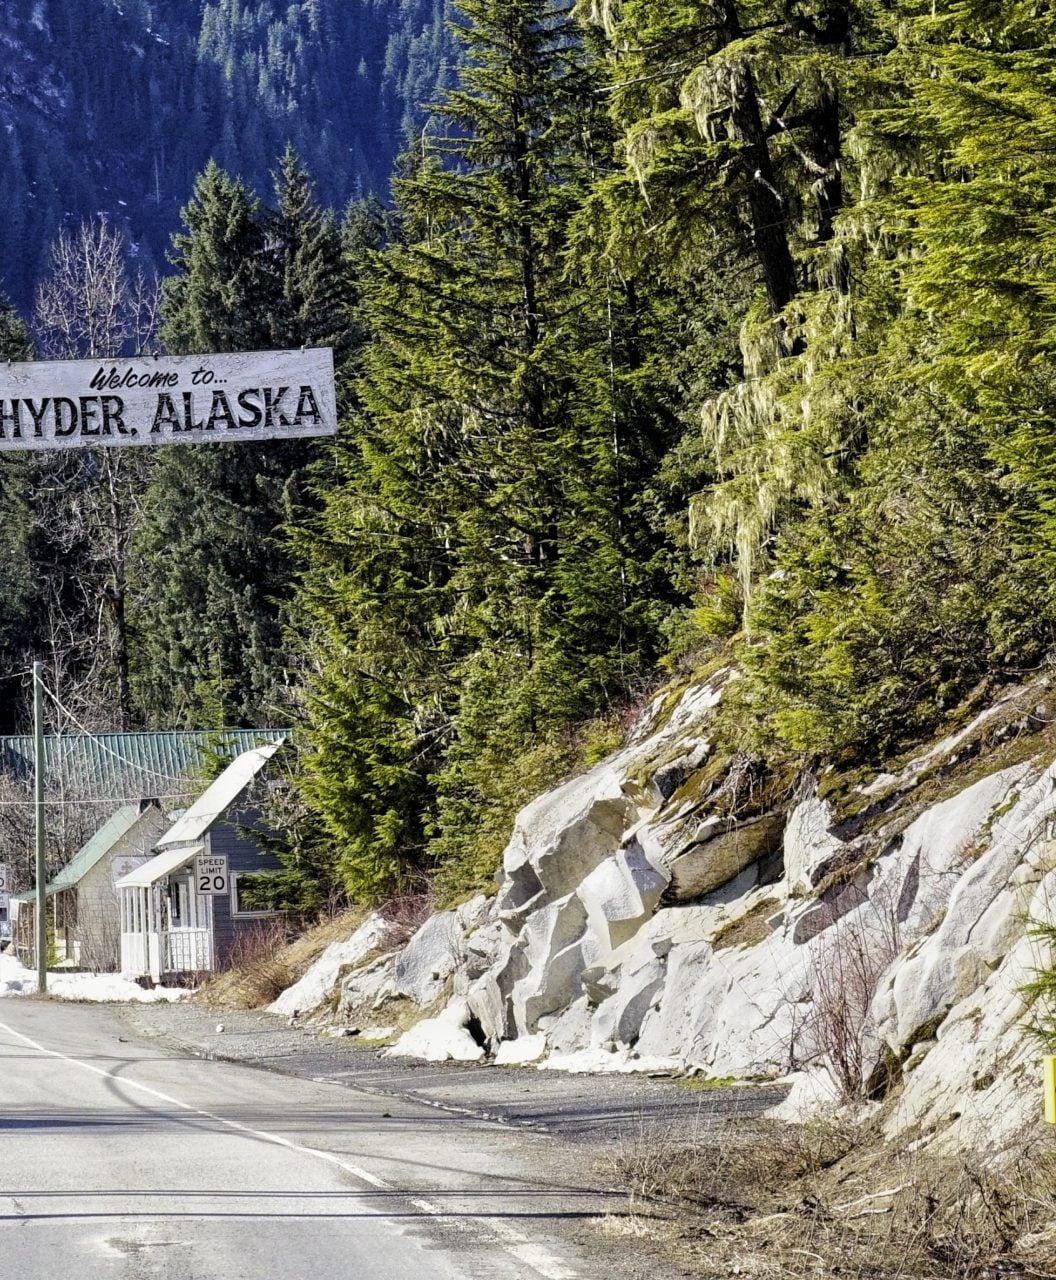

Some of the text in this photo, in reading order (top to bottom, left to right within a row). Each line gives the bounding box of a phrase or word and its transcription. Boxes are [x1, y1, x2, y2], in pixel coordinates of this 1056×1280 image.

[89, 365, 227, 391] Welcome to...
[149, 385, 323, 433] ALASKA
[198, 858, 225, 866] SPEED
[199, 875, 225, 891] 20
